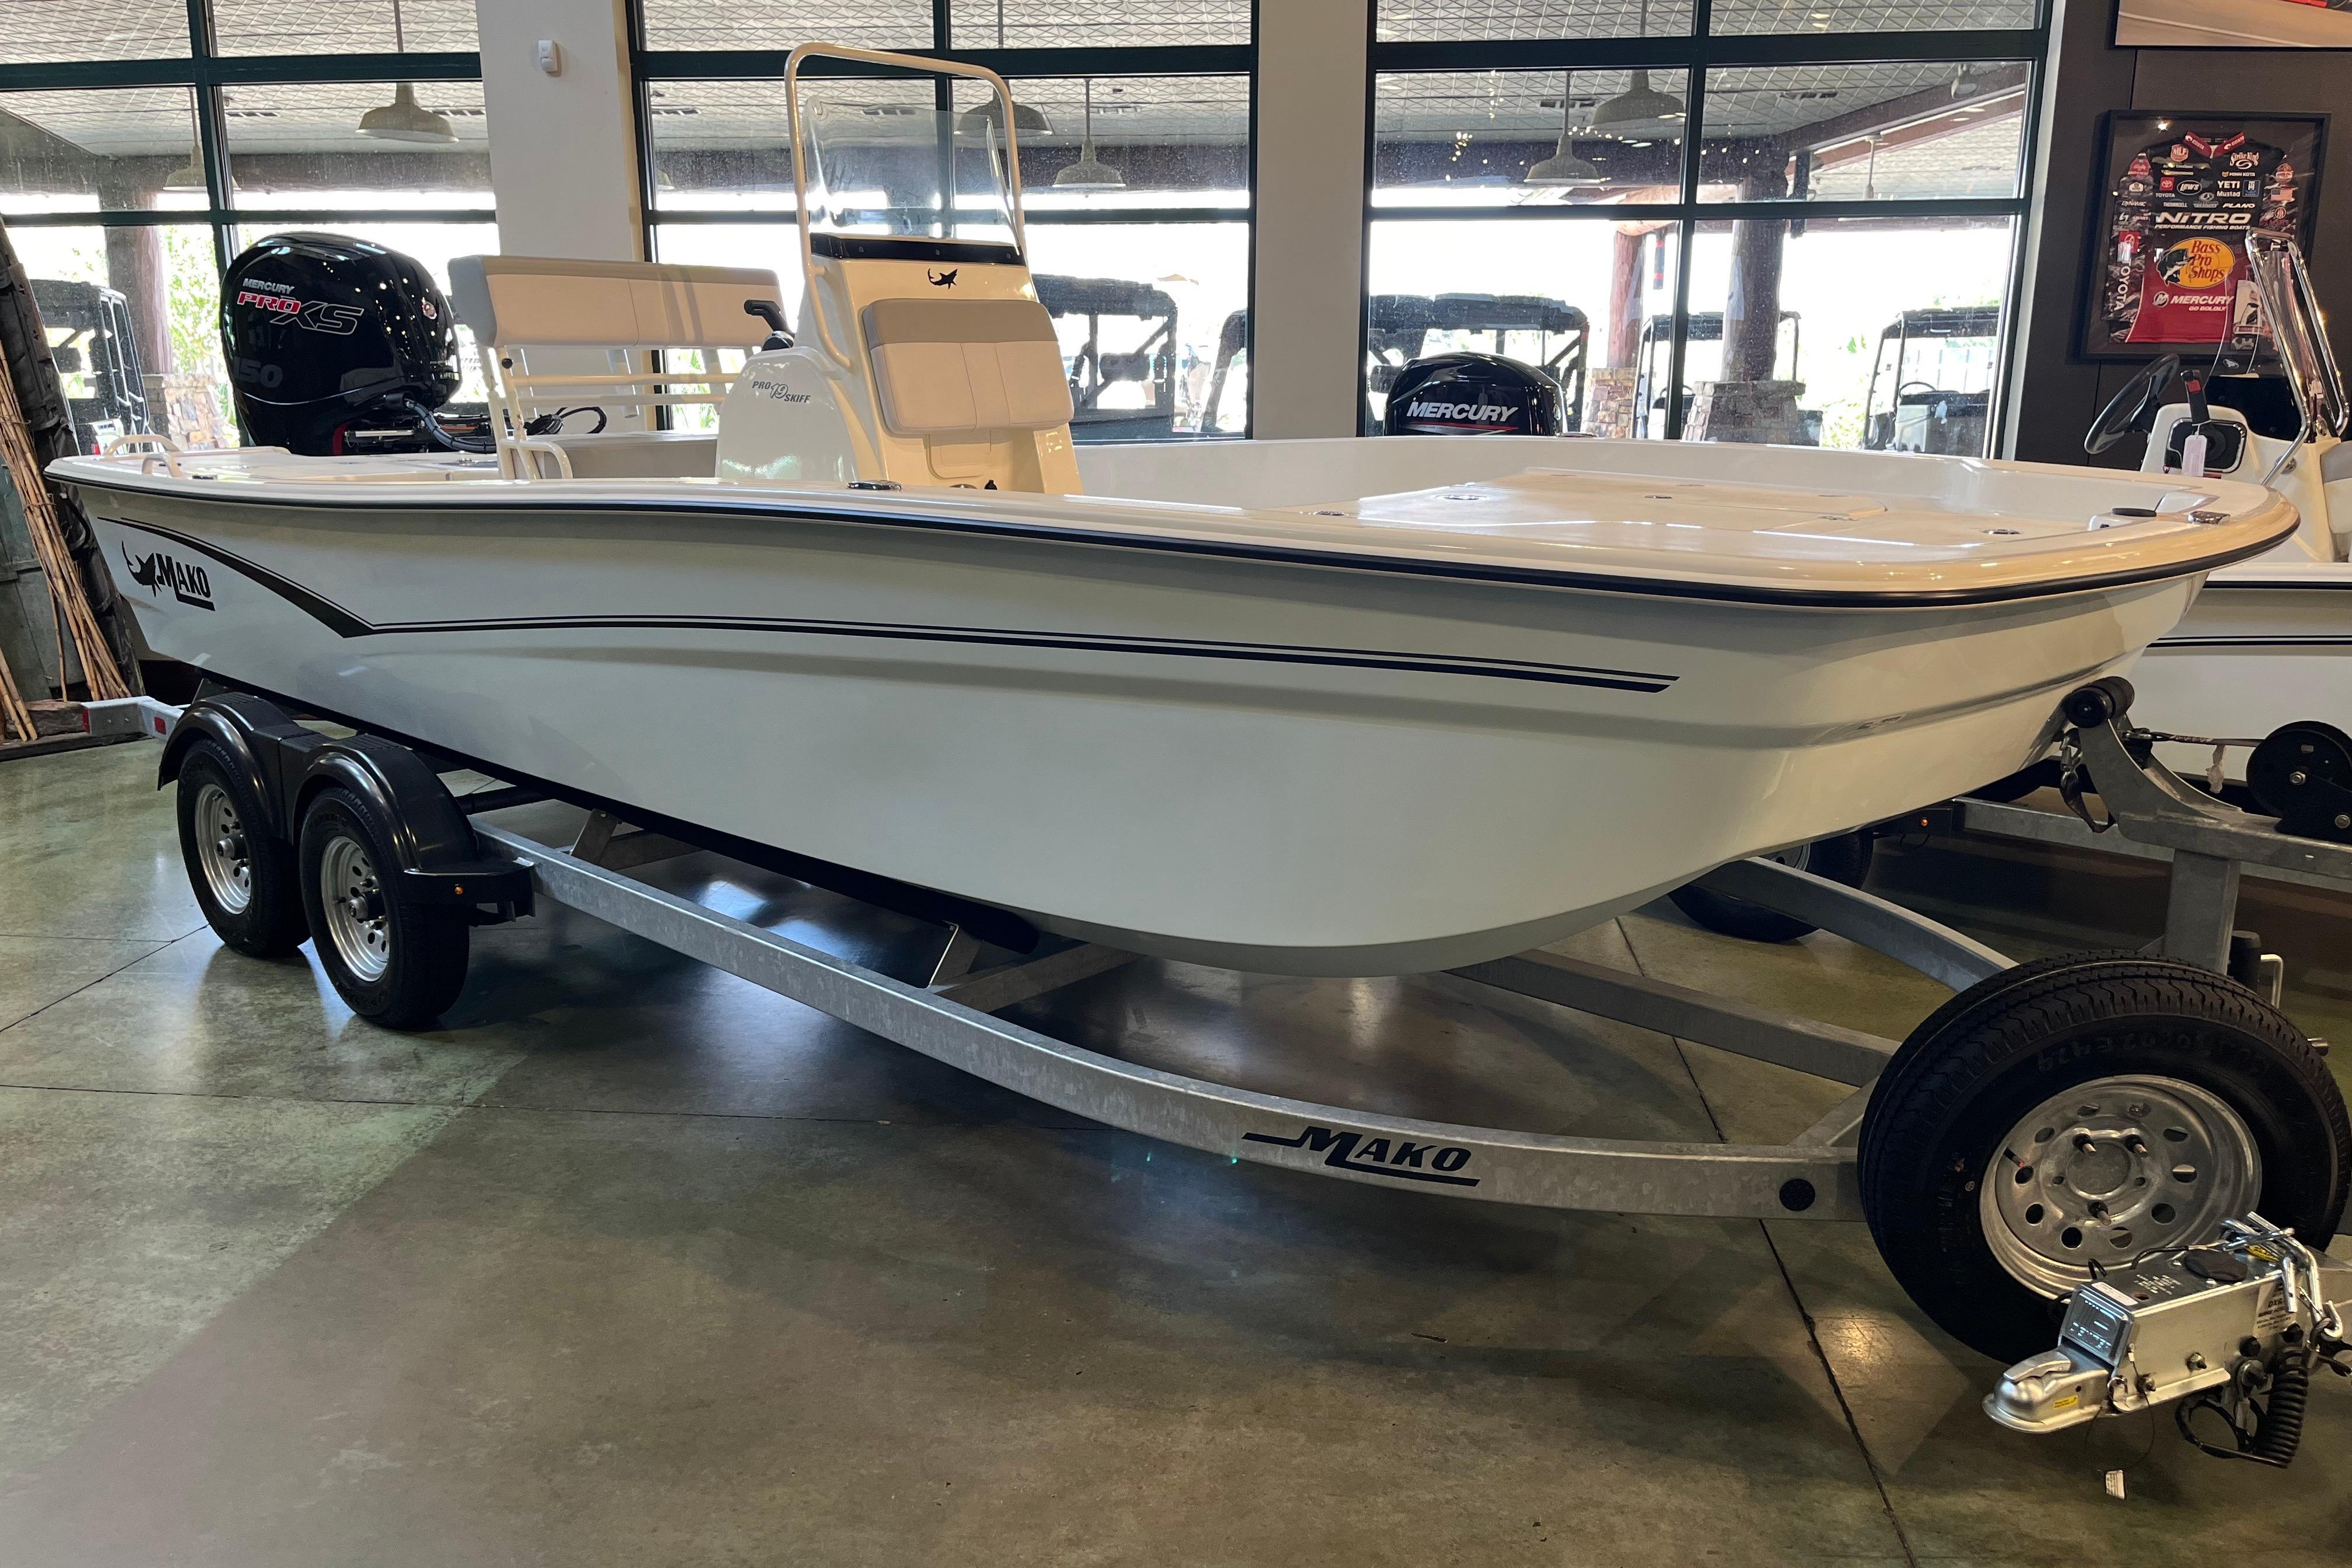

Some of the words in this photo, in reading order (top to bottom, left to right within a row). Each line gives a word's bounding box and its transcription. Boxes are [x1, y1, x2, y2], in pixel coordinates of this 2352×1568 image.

[2217, 180, 2240, 188] YETI
[2190, 240, 2221, 254] Bass
[2190, 254, 2212, 266] Pro
[2188, 266, 2225, 282] Shops
[243, 278, 295, 294] MERCURY
[2170, 295, 2235, 304] MERCURY
[237, 291, 301, 314] PRO
[270, 300, 365, 335] XS
[752, 381, 771, 390] PRO
[770, 383, 789, 399] 19
[784, 394, 811, 402] SKIFF
[1406, 401, 1518, 422] MERCURY
[156, 552, 215, 611] MAKO
[1241, 1125, 1480, 1187] MAKO
